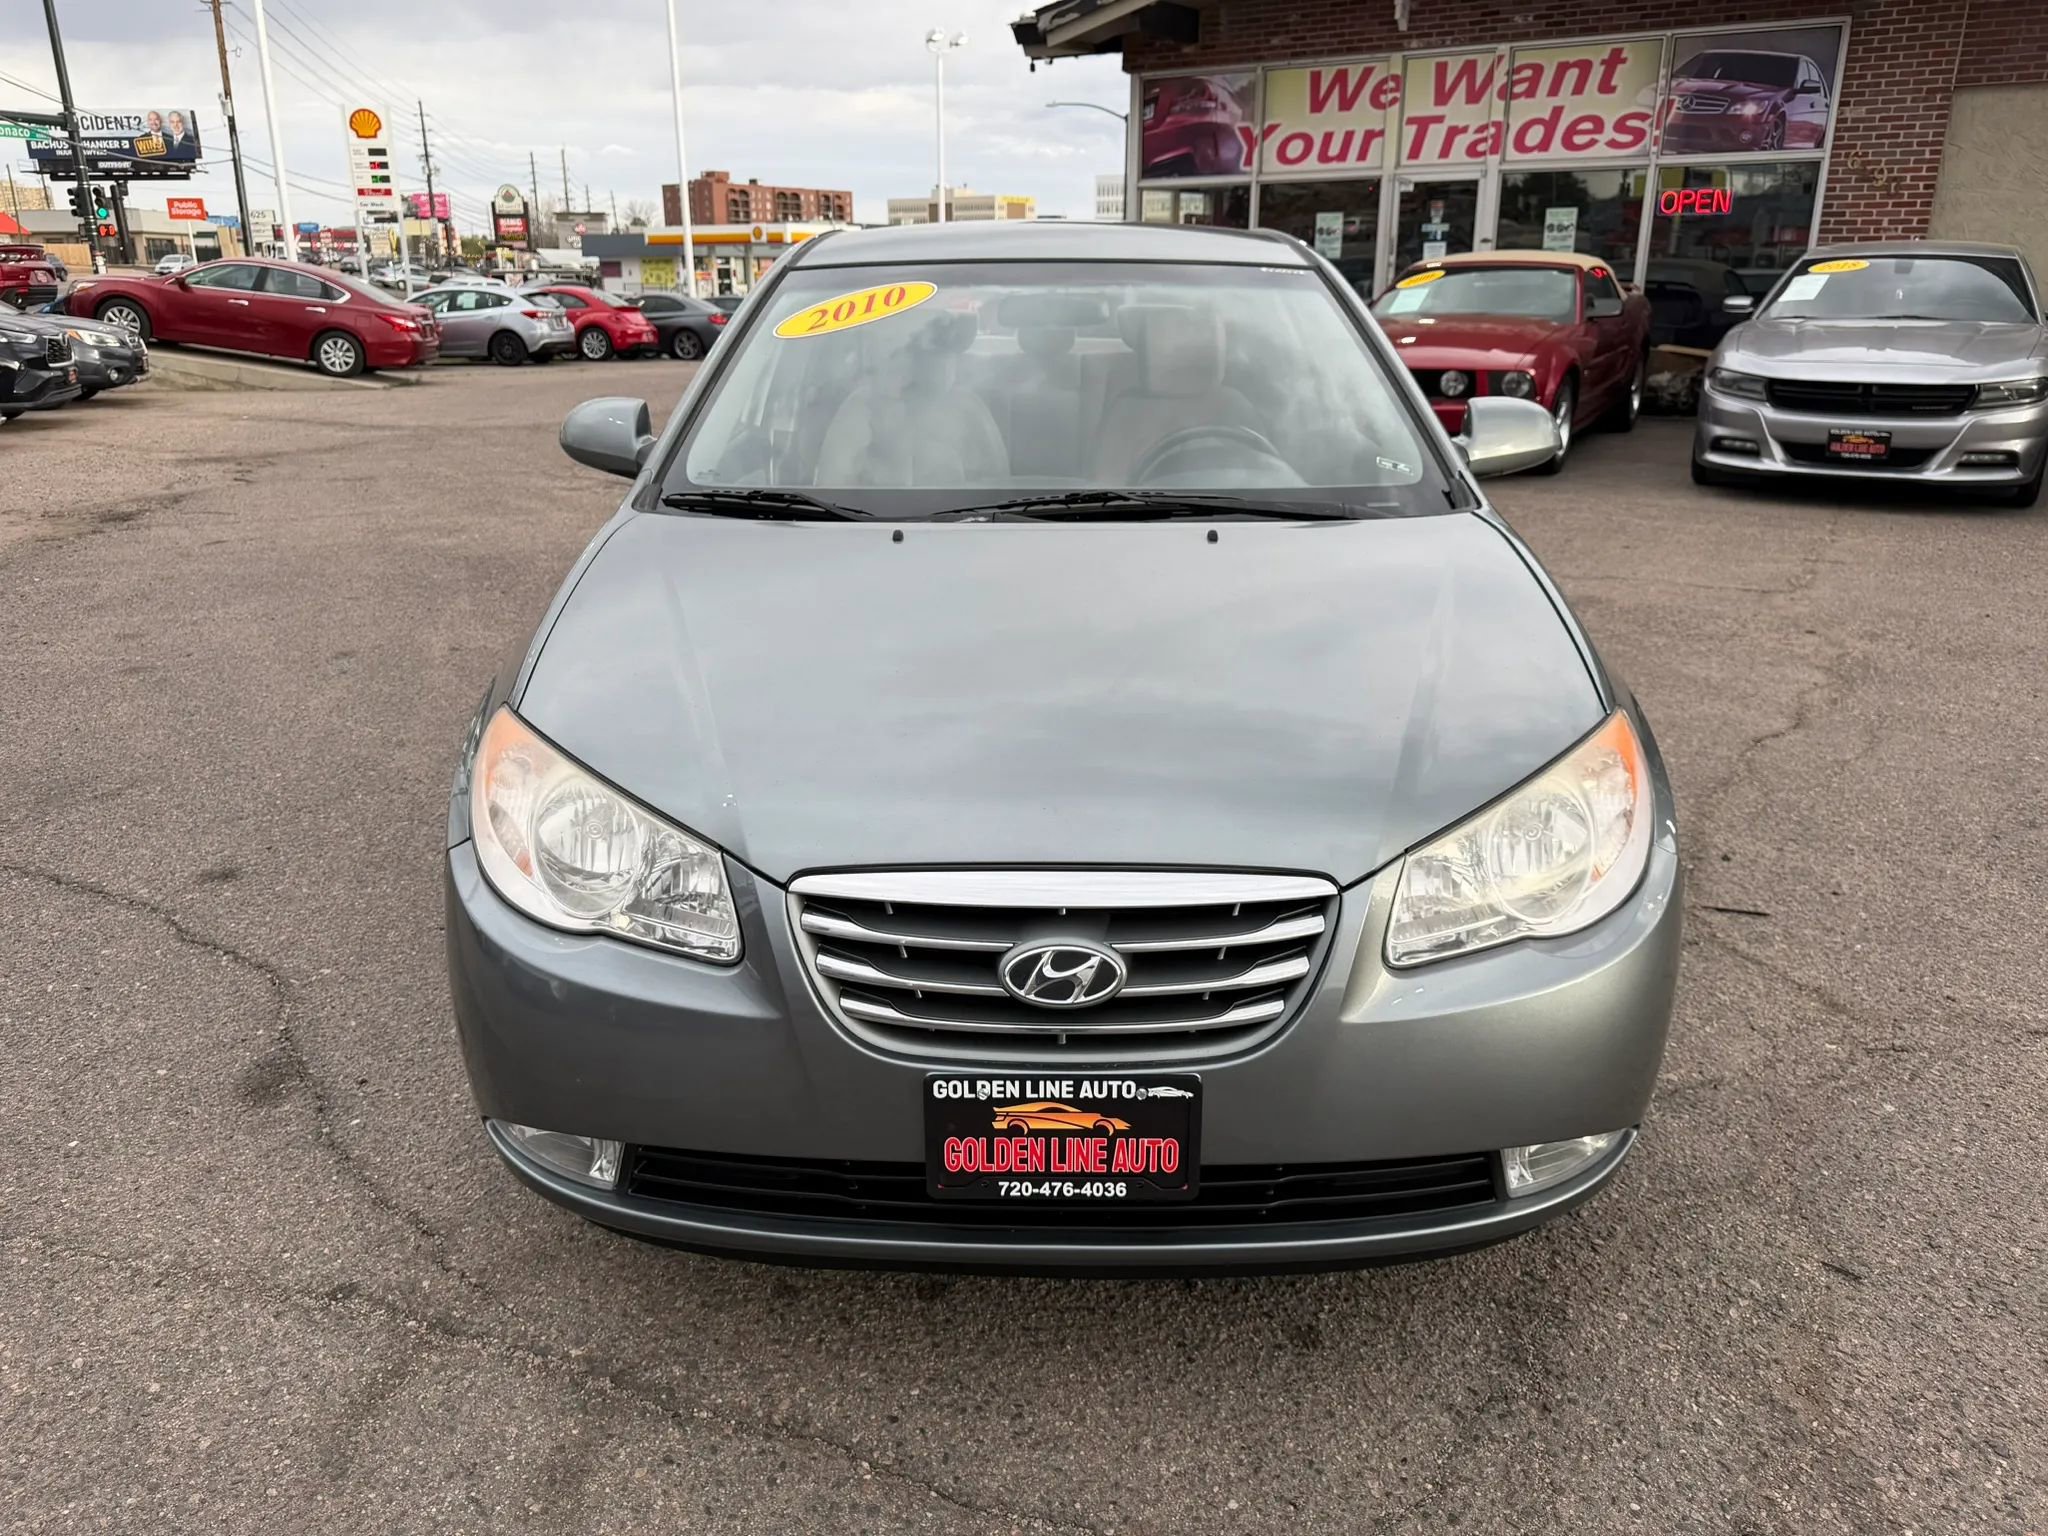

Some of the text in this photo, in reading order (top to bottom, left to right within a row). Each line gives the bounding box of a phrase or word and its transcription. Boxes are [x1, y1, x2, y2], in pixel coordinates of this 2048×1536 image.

[1308, 47, 1628, 114] We Want
[0, 126, 31, 138] onaco
[80, 115, 142, 131] CIDENT?
[83, 140, 120, 149] HANKER
[1238, 122, 1385, 167] Your
[1660, 188, 1732, 214] OPEN
[171, 208, 202, 216] Storage
[806, 286, 906, 332] 2010
[932, 1080, 1137, 1099] GOLDEN LINE AUTO
[944, 1137, 1180, 1174] GOLDEN LINE AUTO
[998, 1181, 1127, 1197] 720-476-4036
